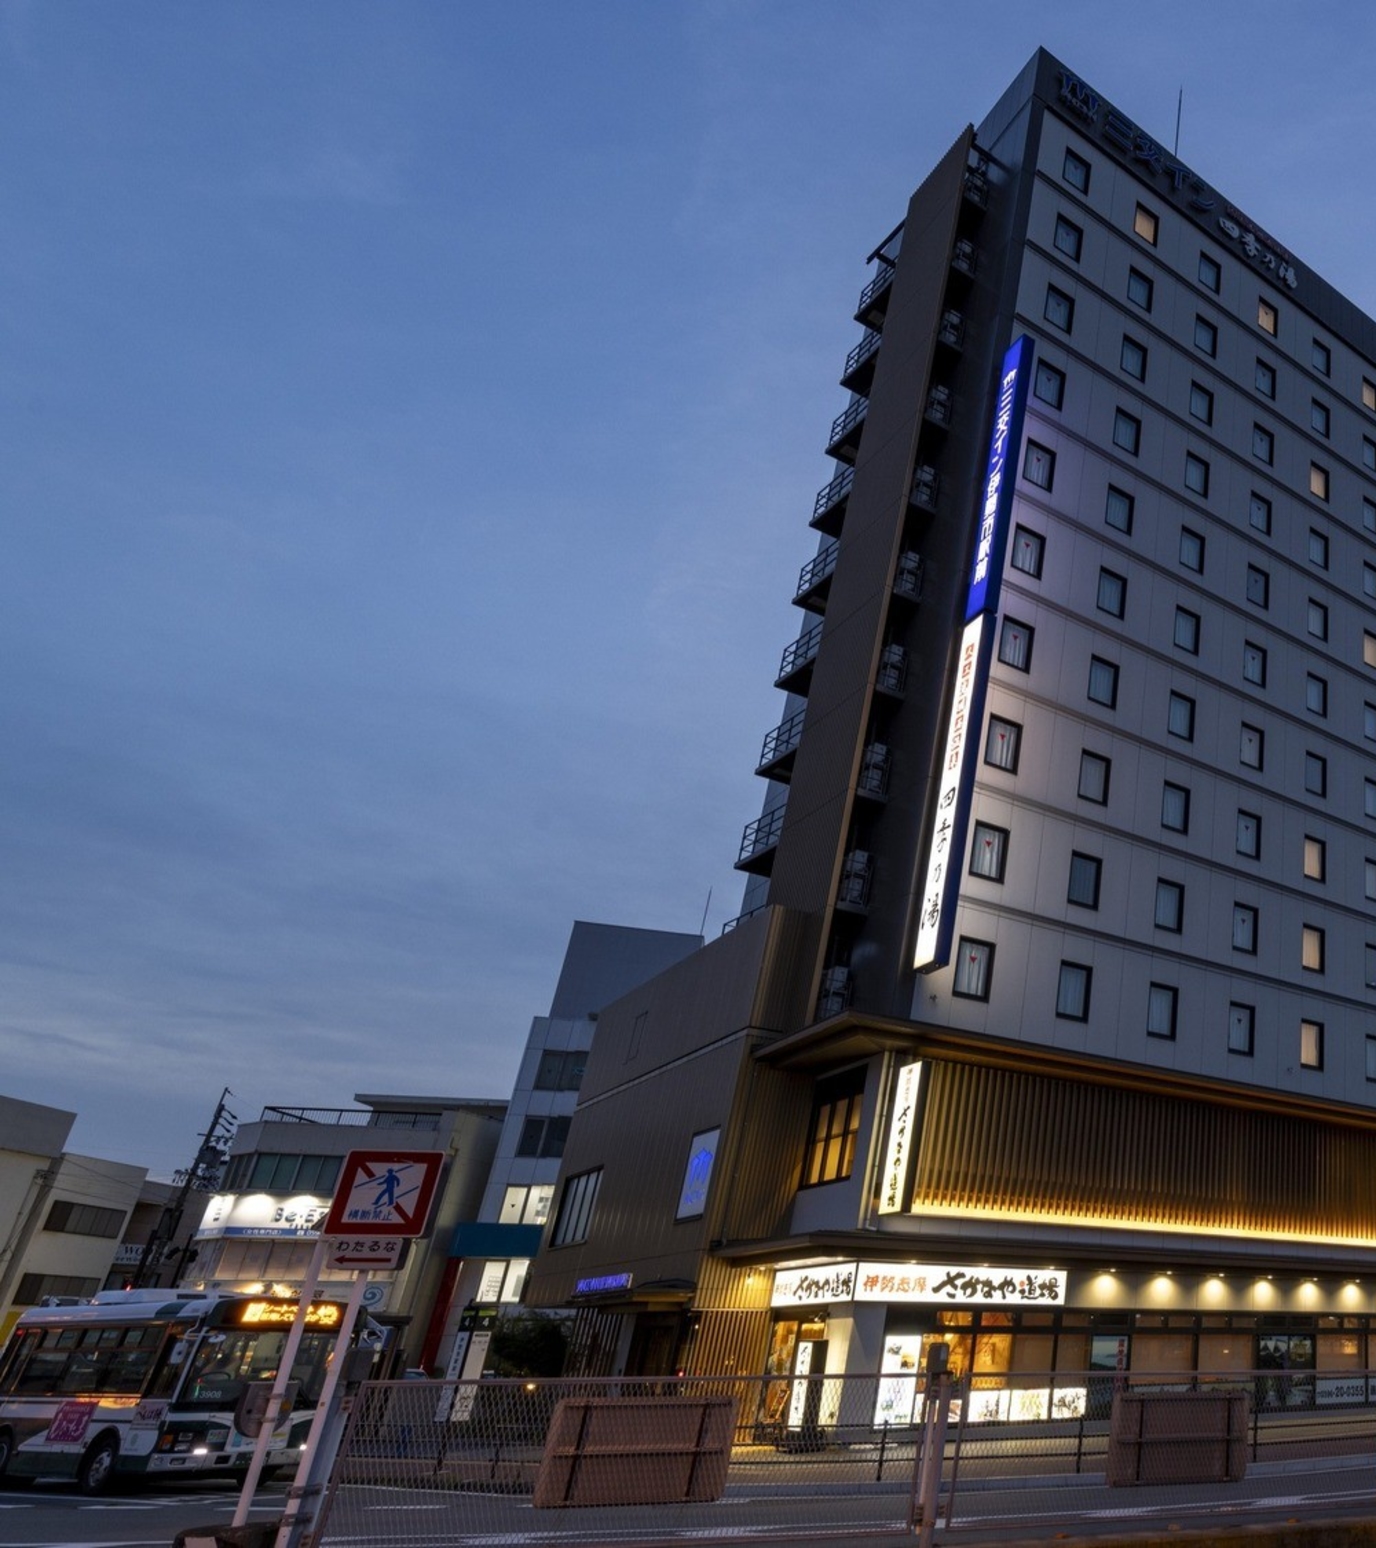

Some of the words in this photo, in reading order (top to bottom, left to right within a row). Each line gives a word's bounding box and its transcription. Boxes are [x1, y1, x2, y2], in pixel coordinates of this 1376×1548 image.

[1105, 109, 1214, 211] 三交イン
[921, 785, 958, 931] 四季乃湯
[347, 1208, 393, 1222] 横断禁止
[336, 1240, 397, 1253] わたるな
[793, 1272, 852, 1301] さかなや道場
[932, 1271, 1060, 1301] さかなや道場
[264, 1304, 314, 1314] シートベト
[482, 1317, 490, 1327] 4
